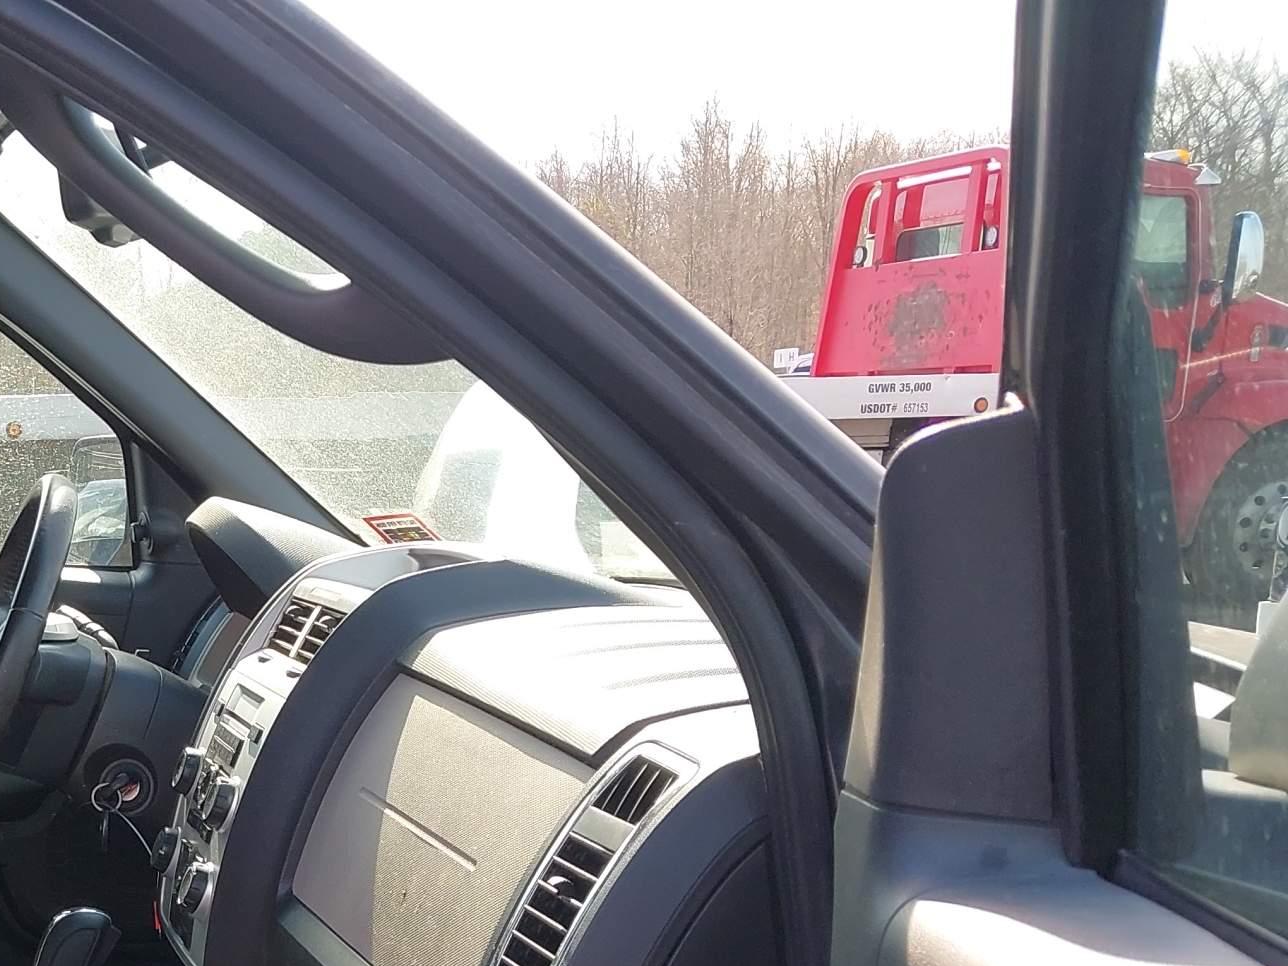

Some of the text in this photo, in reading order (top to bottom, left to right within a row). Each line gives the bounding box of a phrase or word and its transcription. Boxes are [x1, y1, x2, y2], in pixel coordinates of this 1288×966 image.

[868, 382, 932, 394] GVWR 35,000
[860, 402, 929, 414] USDOT# 657153
